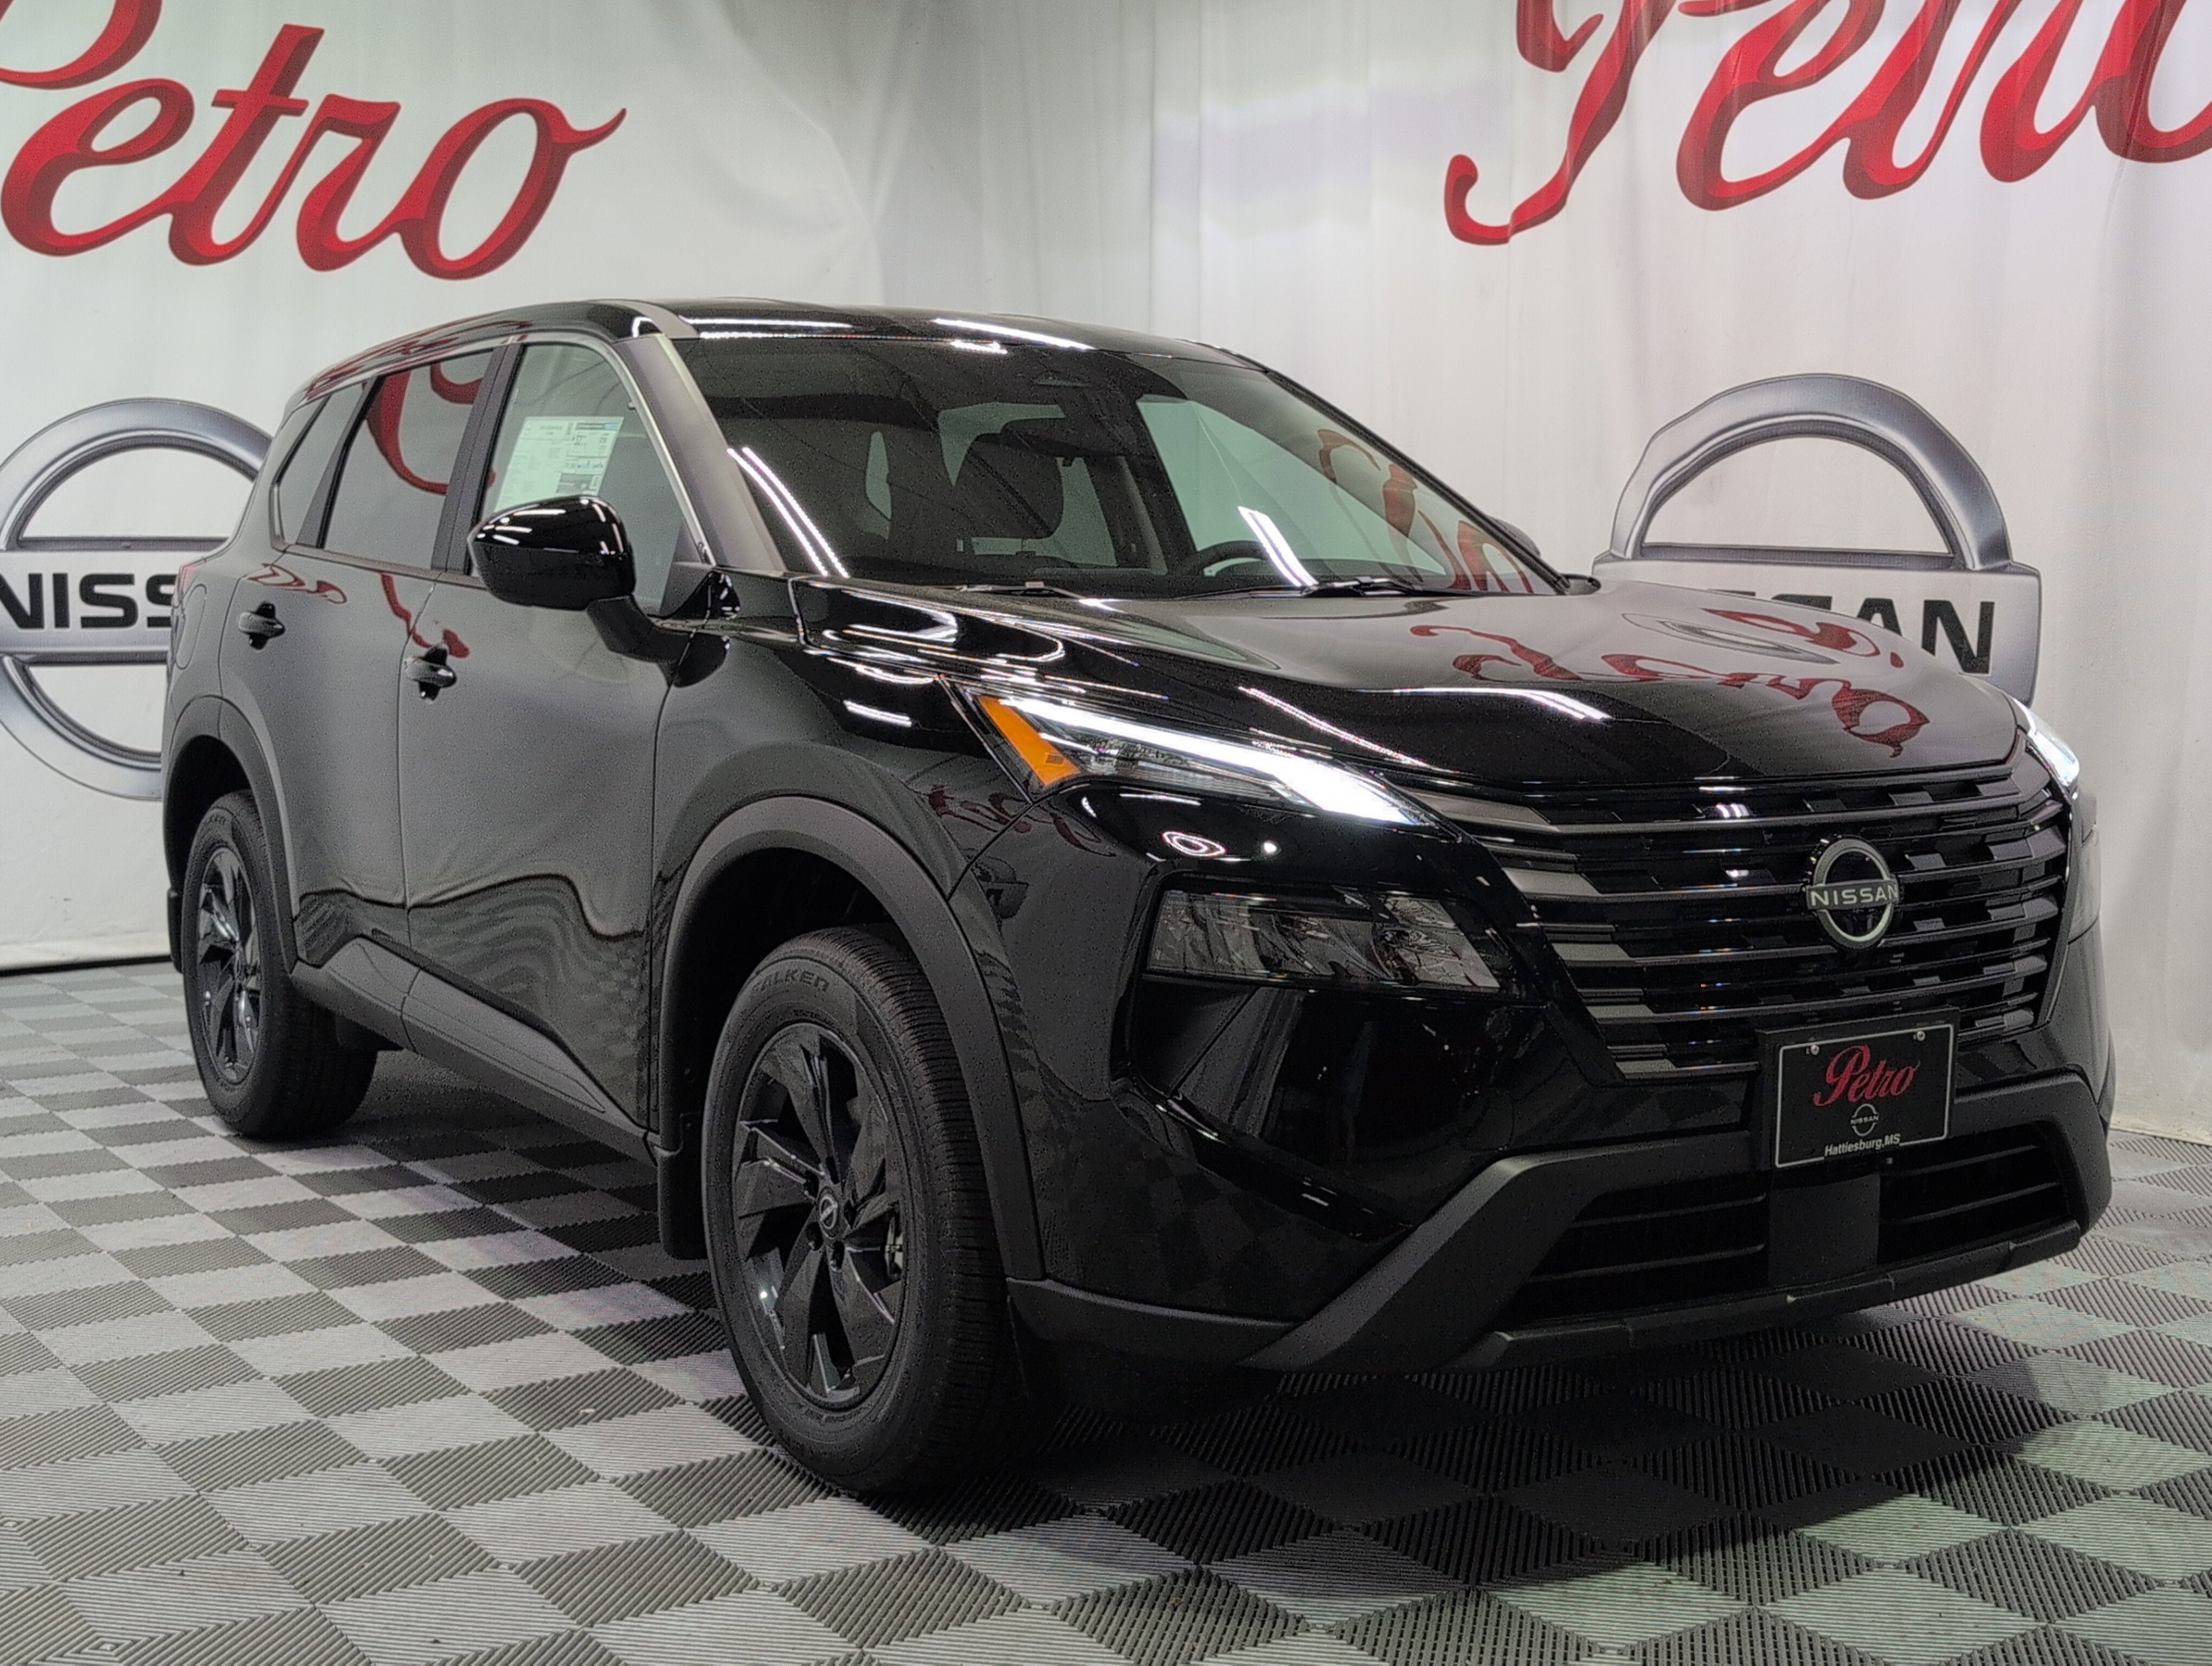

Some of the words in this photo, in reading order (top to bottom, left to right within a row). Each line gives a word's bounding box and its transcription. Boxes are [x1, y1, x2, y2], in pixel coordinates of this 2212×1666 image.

[0, 0, 627, 280] etro
[1811, 885, 1898, 906] NISSAN
[1812, 1045, 1921, 1106] Petro
